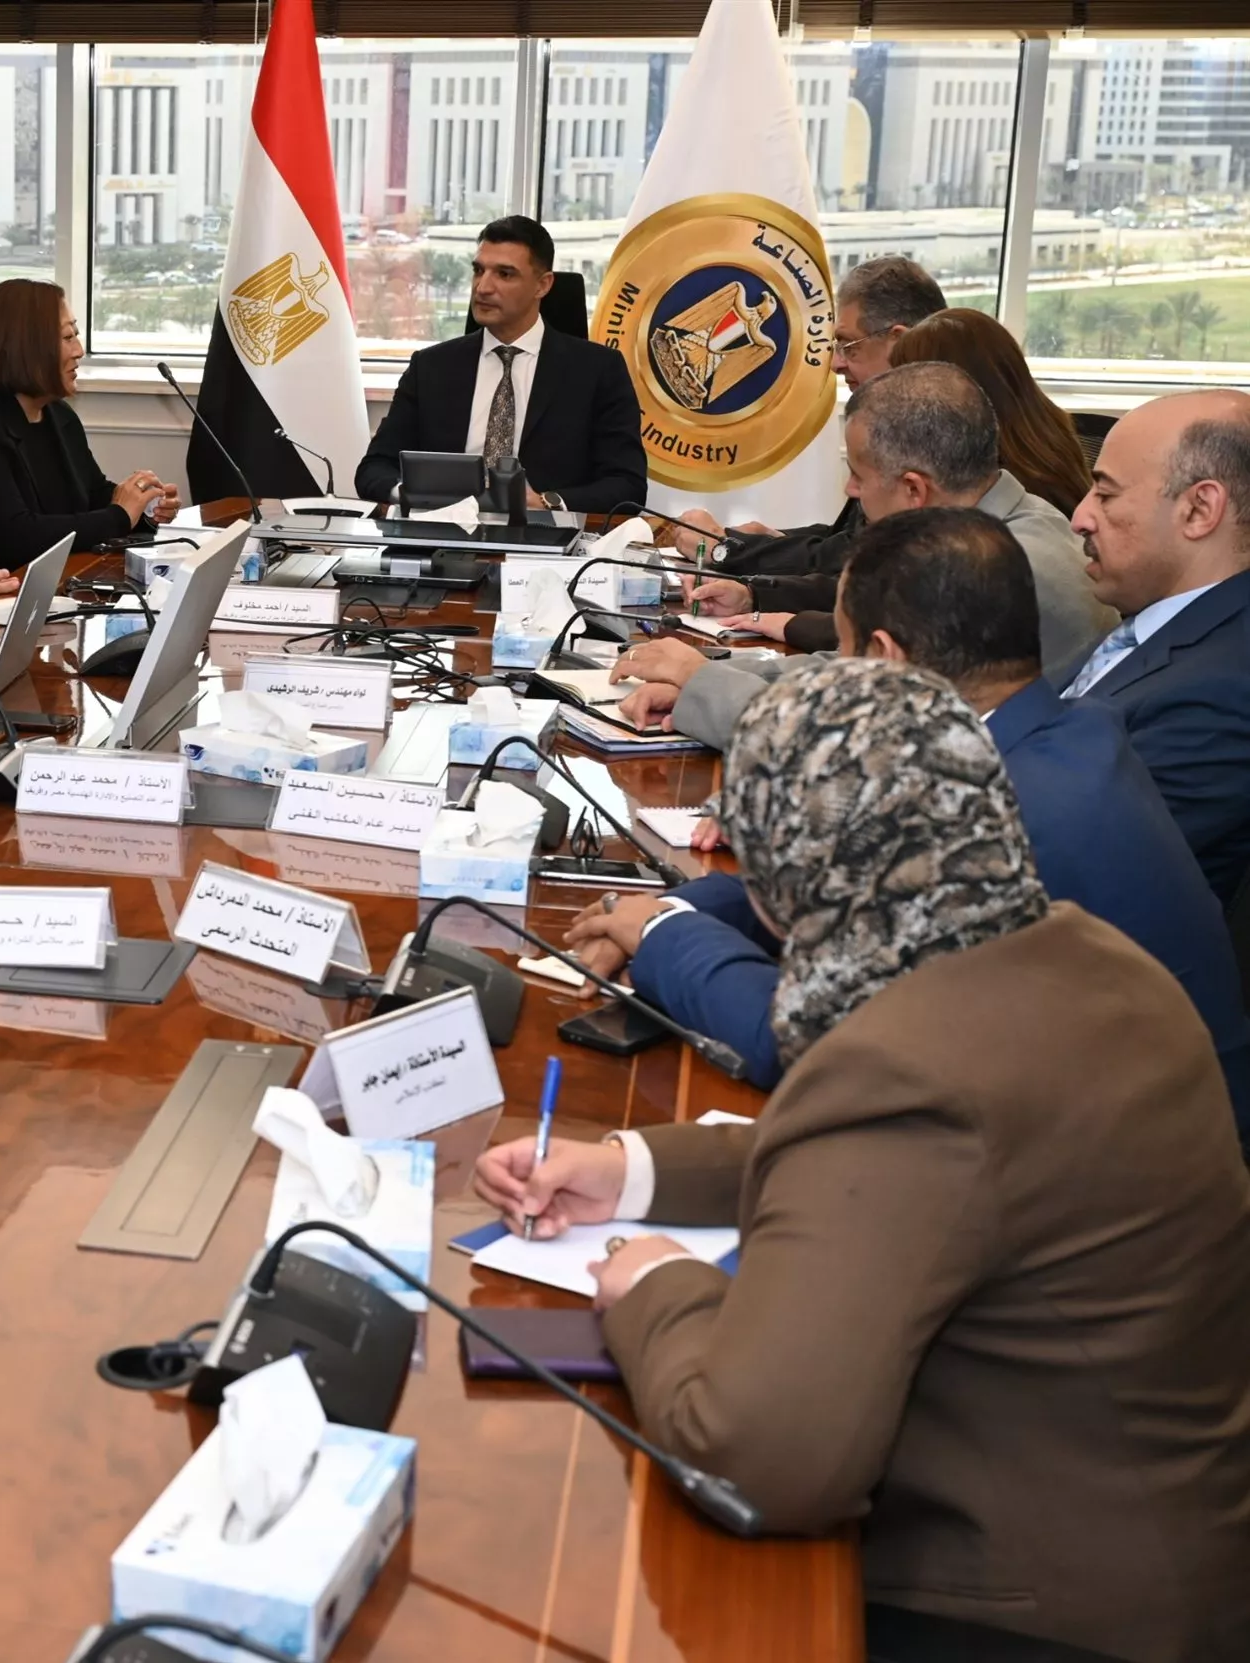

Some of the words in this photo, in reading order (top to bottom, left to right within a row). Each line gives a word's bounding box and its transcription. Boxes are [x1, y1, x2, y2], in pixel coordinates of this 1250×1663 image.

[752, 224, 825, 308] الصناعة
[605, 282, 641, 350] Minis
[805, 313, 834, 368] وزارة
[642, 422, 739, 465] Industry
[291, 602, 311, 613] السيد
[298, 685, 320, 696] شريف
[326, 687, 352, 698] مهندس
[30, 770, 66, 784] الرحمن
[70, 773, 86, 785] عبد
[91, 775, 118, 785] محمد
[288, 779, 334, 793] السعيد
[336, 784, 386, 800] حسين
[399, 788, 439, 808] الأستاذ
[323, 812, 363, 827] المكتب
[365, 818, 384, 829] عام
[388, 822, 422, 834] مدير
[196, 882, 249, 908] الدمرداش
[252, 897, 283, 919] محمد
[45, 914, 78, 928] السيد
[249, 930, 299, 958] المتحدث
